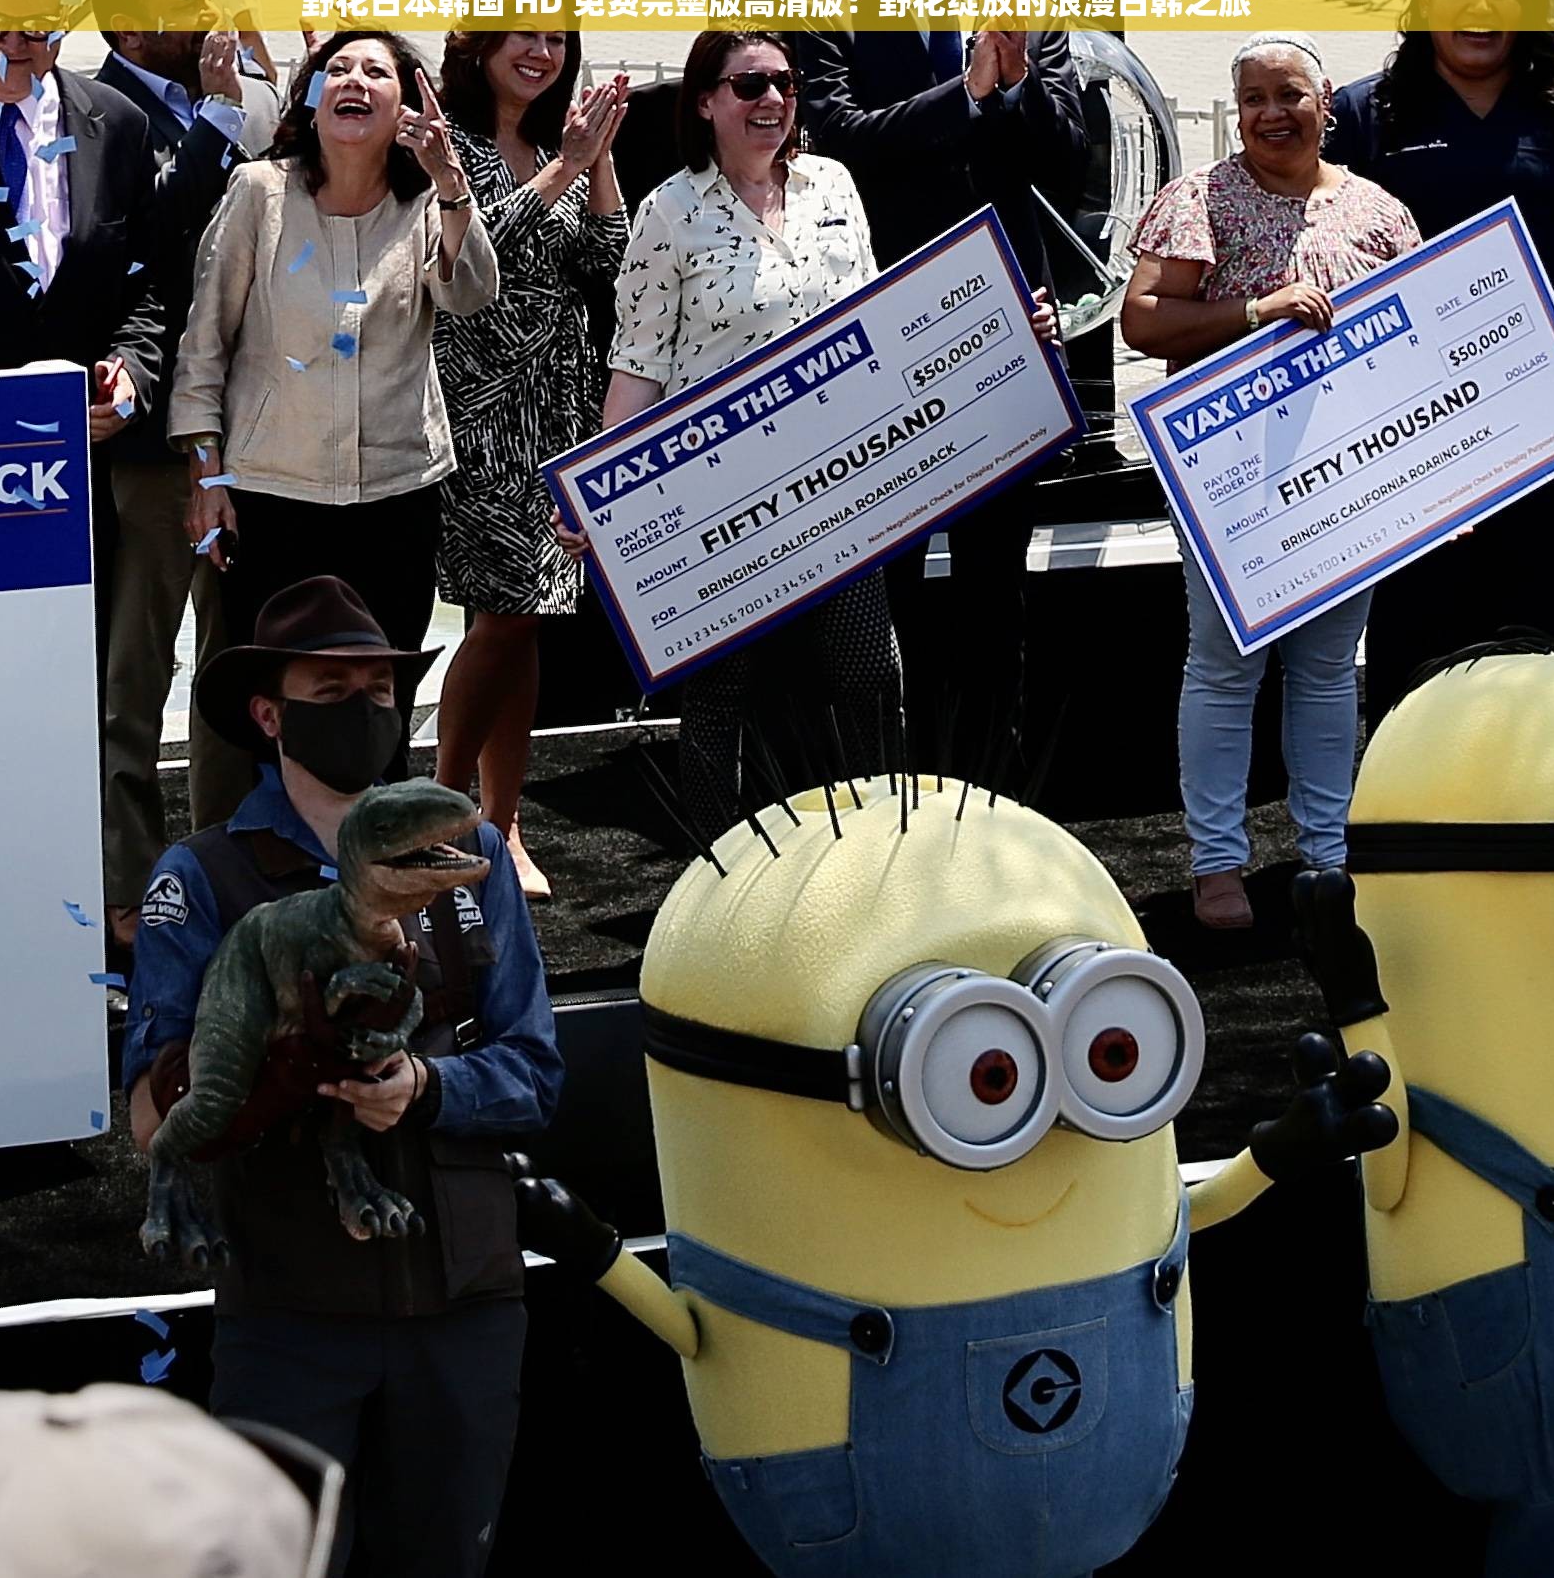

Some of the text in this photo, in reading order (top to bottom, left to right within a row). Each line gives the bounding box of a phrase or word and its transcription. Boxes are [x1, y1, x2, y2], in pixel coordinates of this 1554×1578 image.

[901, 274, 987, 337] DATE 6/11/21
[1435, 267, 1509, 317] DATE 6/11/21
[975, 354, 1026, 392] DOLLARS
[1173, 305, 1404, 441] VAX FOR THE WIN
[1505, 352, 1548, 381] DOLLARS
[586, 333, 862, 499] VAX FOR THE WIN
[1277, 380, 1480, 506] FIFTY THOUSAND
[700, 397, 947, 555] FIFTY THOUSAND
[929, 489, 953, 507] Check
[954, 479, 966, 491] for
[966, 463, 994, 485] Display
[995, 439, 1029, 465] Purposes
[1029, 427, 1048, 443] Only
[1203, 453, 1263, 491] PAY TO THE
[1208, 468, 1262, 502] ORDER OF
[1280, 425, 1493, 552] BRINGING CALIFORNIA ROARING BACK
[614, 504, 685, 549] PAY TO THE
[620, 519, 683, 558] ORDER OF
[698, 441, 958, 601] BRINGING CALIFORNIA ROARING BACK
[1225, 506, 1270, 538] AMOUNT
[635, 556, 689, 591] AMOUNT
[1242, 555, 1264, 573] FOR
[651, 606, 678, 625] FOR
